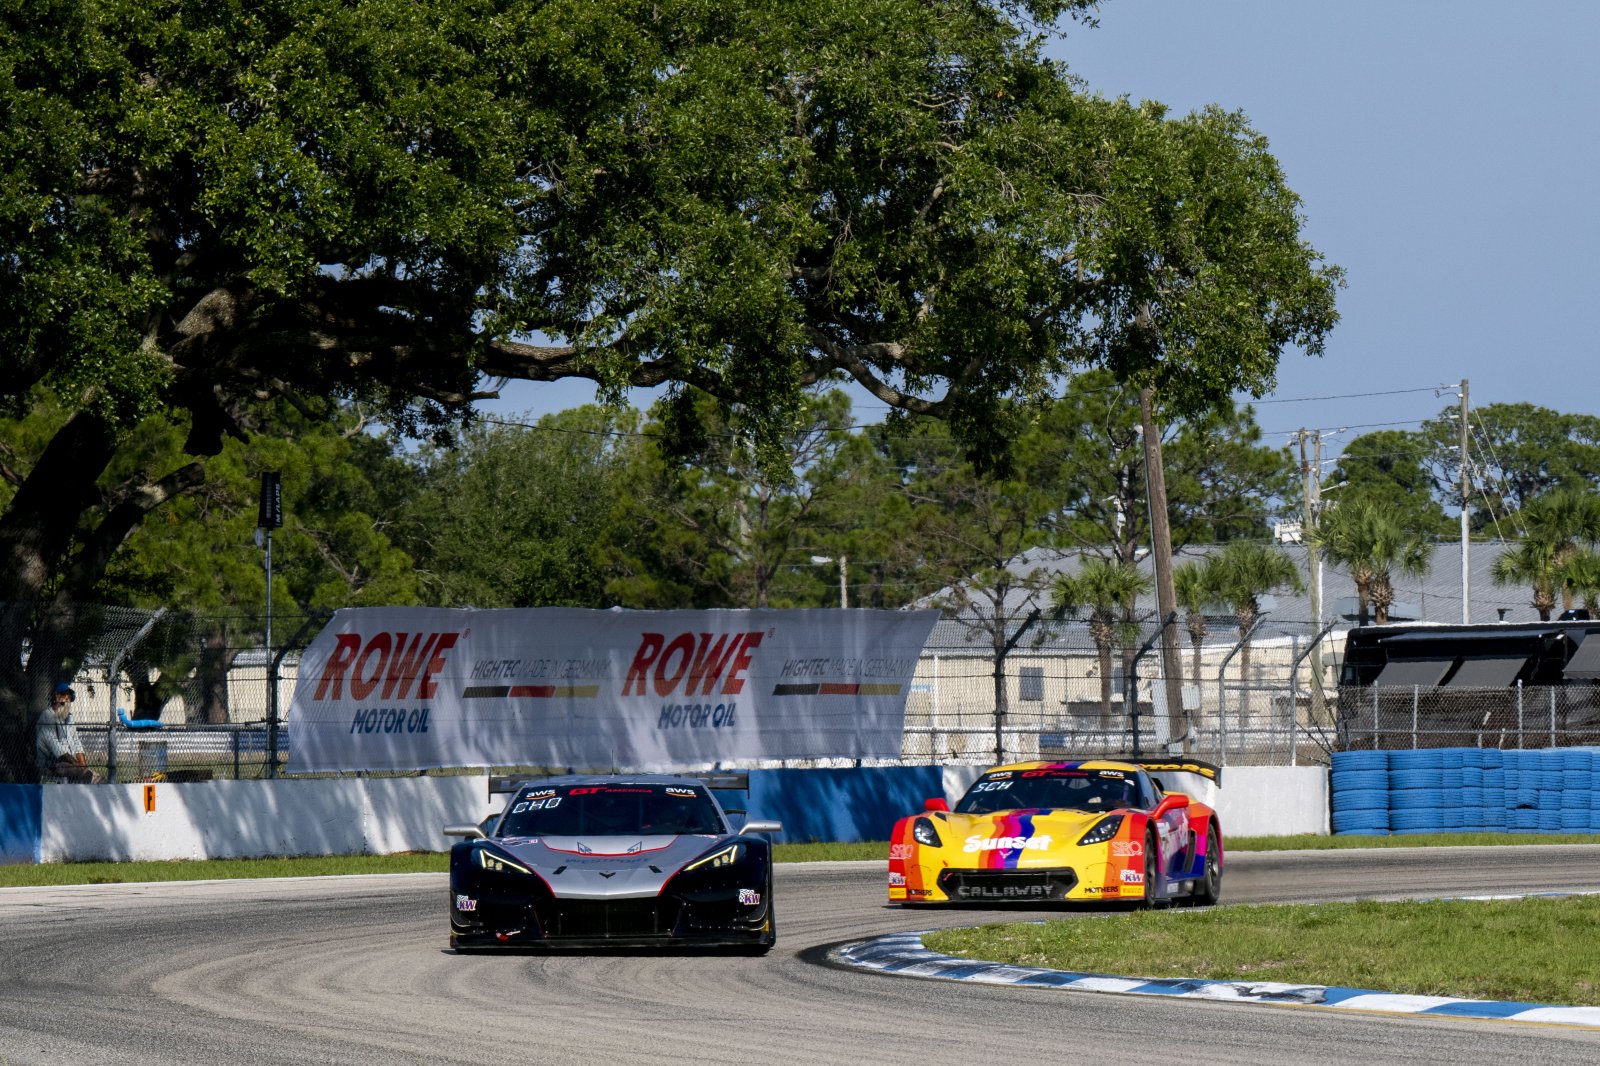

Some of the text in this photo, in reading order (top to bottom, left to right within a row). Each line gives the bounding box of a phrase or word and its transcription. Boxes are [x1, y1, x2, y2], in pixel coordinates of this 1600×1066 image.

[313, 632, 460, 701] ROWE
[470, 659, 521, 679] HIGHTEC
[621, 631, 765, 697] ROWE
[780, 657, 830, 677] HIGHTEC
[350, 707, 431, 734] MOTOR OIL
[657, 703, 736, 729] MOTOR OIL
[989, 771, 1012, 779] aws
[1021, 770, 1055, 778] GT
[1144, 763, 1216, 779] TORS
[527, 789, 556, 798] aws
[569, 787, 608, 796] GT
[665, 787, 695, 796] aws
[973, 781, 1014, 793] SCH
[147, 786, 152, 811] F
[512, 797, 563, 814] CHO
[963, 834, 1053, 853] Sunset
[1111, 840, 1143, 857] SRO
[1124, 873, 1142, 882] KW
[958, 885, 1053, 897] CALLAWAY
[1084, 886, 1119, 894] MOTHERS
[459, 900, 477, 910] KW
[744, 894, 760, 904] KW
